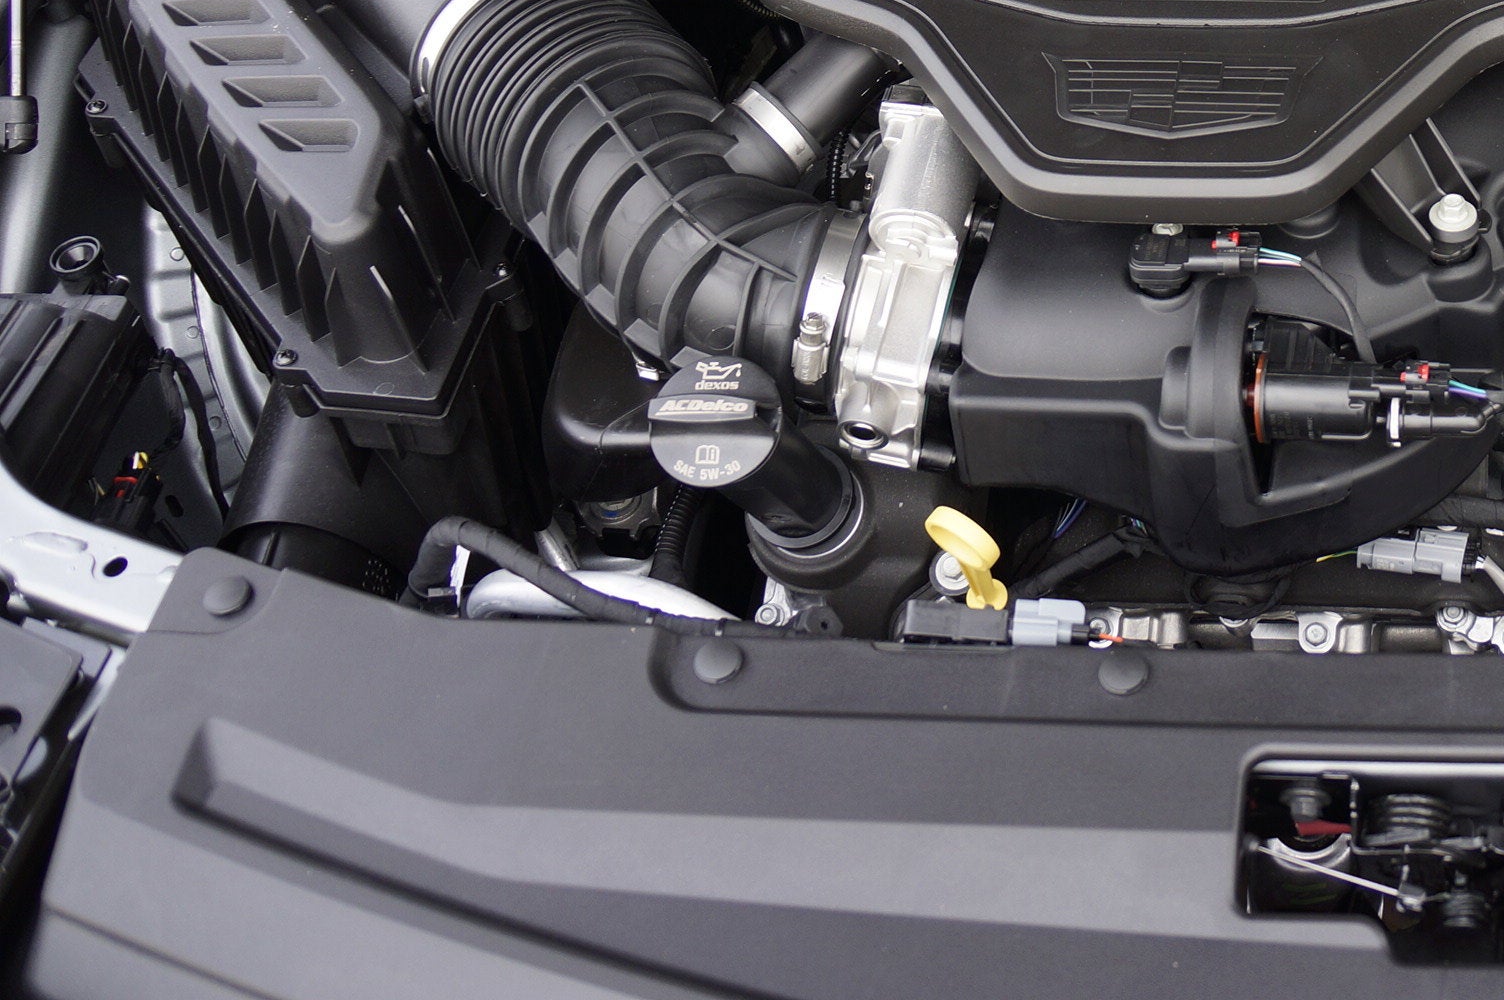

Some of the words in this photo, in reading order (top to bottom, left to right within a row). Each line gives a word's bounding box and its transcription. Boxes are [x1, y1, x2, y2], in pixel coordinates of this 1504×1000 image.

[695, 380, 739, 390] dexos
[659, 399, 748, 412] ACDelco
[673, 460, 696, 478] SAE
[700, 460, 741, 480] 5W-30
